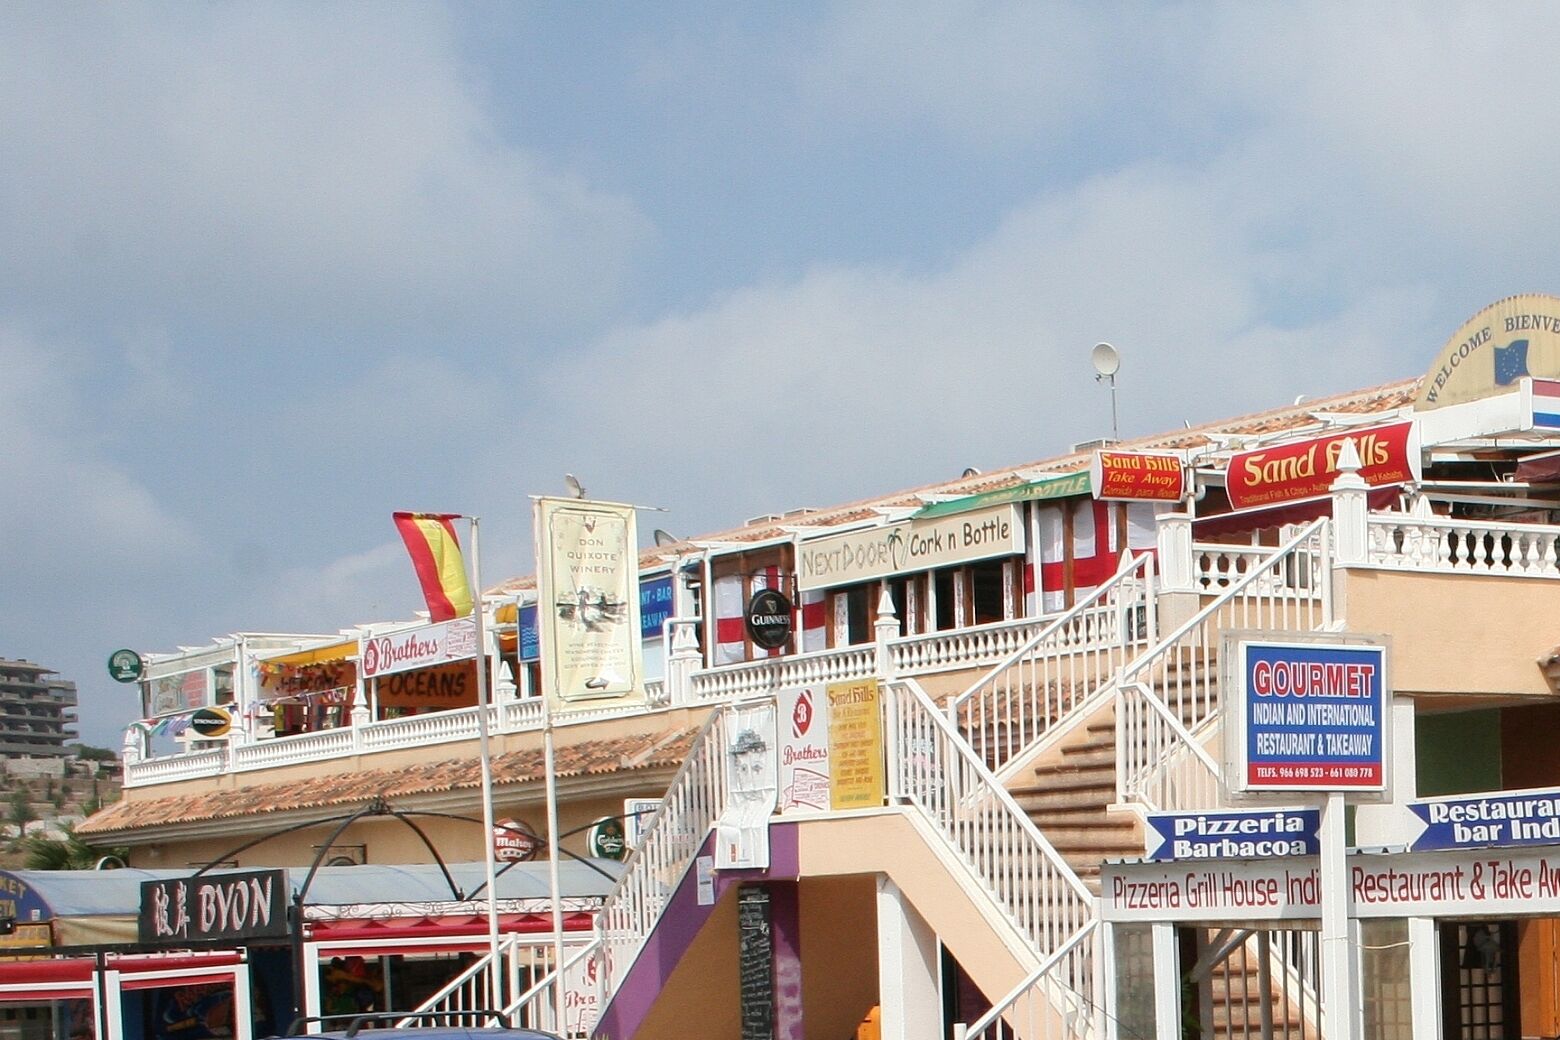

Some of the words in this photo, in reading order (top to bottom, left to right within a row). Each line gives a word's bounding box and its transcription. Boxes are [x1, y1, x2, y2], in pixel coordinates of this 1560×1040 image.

[1426, 326, 1492, 404] WELCOME
[1102, 454, 1141, 469] Sand
[1243, 444, 1318, 487] Sand
[1325, 434, 1389, 474] Hlls
[1108, 471, 1135, 483] Take
[1140, 473, 1177, 488] Away
[579, 538, 604, 547] DON
[910, 528, 943, 557] Cork
[948, 533, 957, 550] n
[963, 516, 1009, 545] Bottle
[567, 552, 617, 561] QUIXOTE
[570, 565, 616, 574] WINERY
[380, 634, 438, 671] Brothers
[389, 671, 466, 697] OCEANS
[1253, 660, 1375, 698] GOURMET
[1254, 703, 1285, 725] INDIAN
[1286, 704, 1305, 725] AND
[1307, 704, 1375, 726] INTERNATIONAL
[783, 744, 828, 766] Brothers
[1257, 733, 1315, 755] RESTAURANT
[1318, 734, 1324, 755] &
[1326, 734, 1373, 756] TAKEAWAY
[1257, 768, 1279, 778] TELFS.
[1279, 768, 1294, 778] 966
[1295, 768, 1309, 778] 698
[1310, 768, 1324, 778] 523
[1360, 768, 1373, 778] 778
[1174, 814, 1305, 836] Pizzeria
[1454, 821, 1502, 843] bar
[1174, 838, 1307, 860] Barbacoa
[1113, 874, 1180, 910] Pizzeria
[1185, 871, 1218, 908] Grill
[1222, 872, 1279, 906] House
[1353, 864, 1465, 904] Restaurant
[1470, 861, 1486, 900] &
[1488, 860, 1532, 900] Take
[198, 875, 272, 933] BYON
